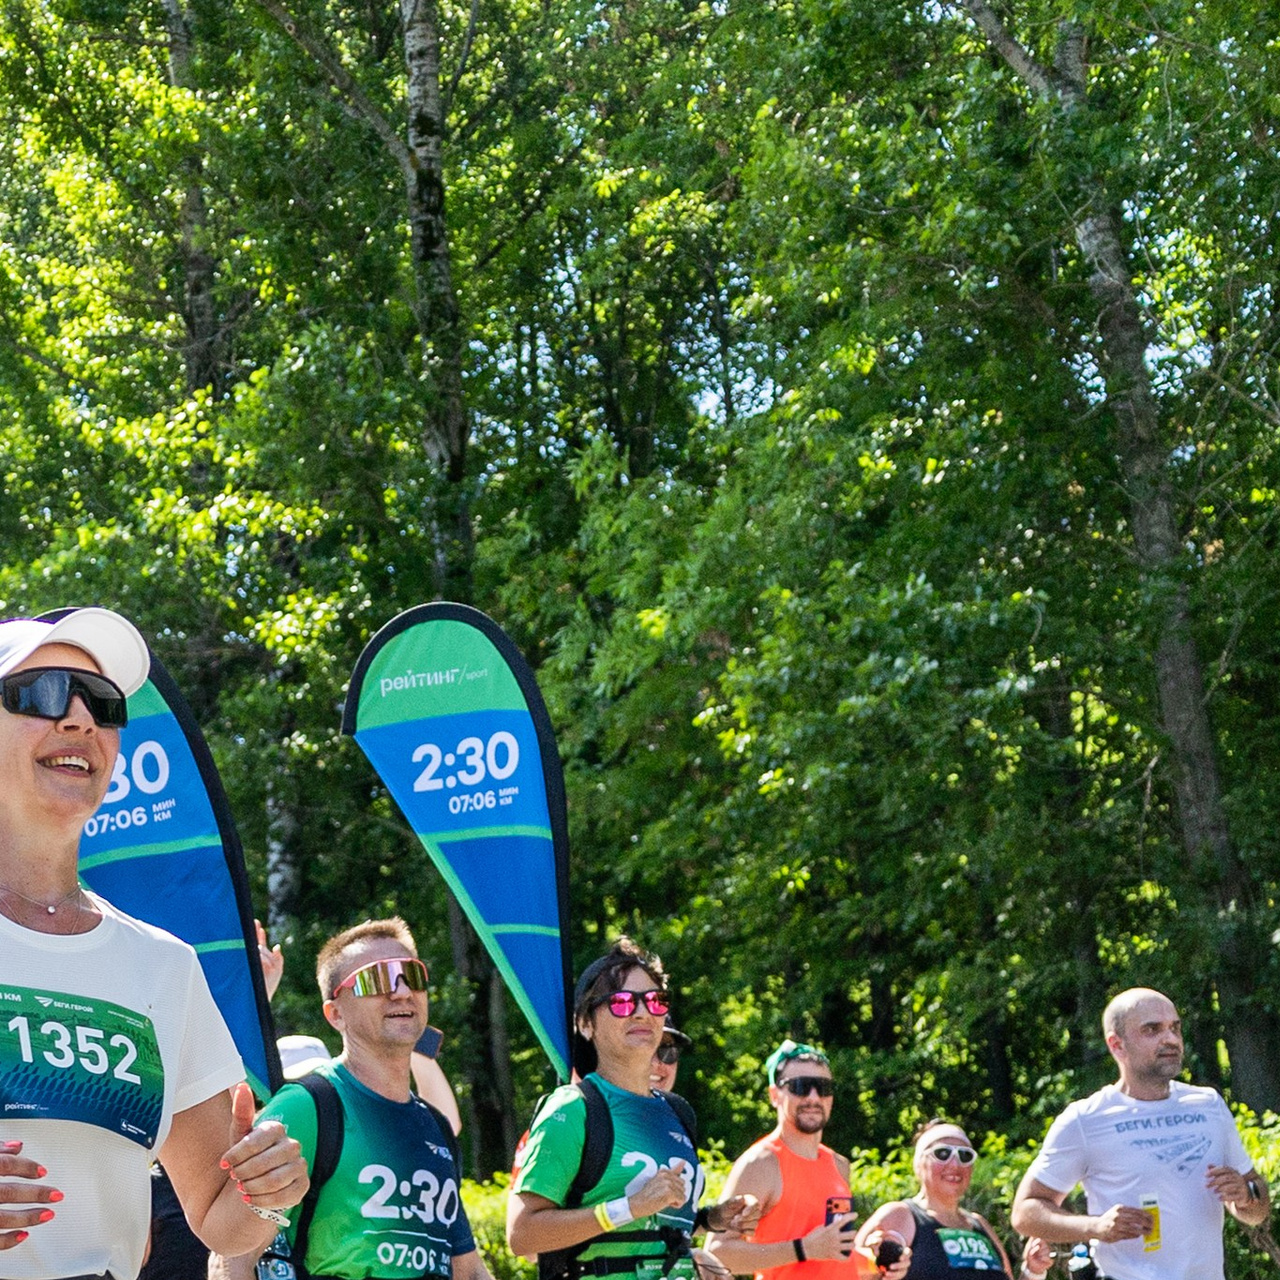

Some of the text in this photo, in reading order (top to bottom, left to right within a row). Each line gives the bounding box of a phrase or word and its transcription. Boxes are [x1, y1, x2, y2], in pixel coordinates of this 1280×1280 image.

[411, 731, 519, 792] 2:30
[152, 798, 176, 812] МИН
[153, 810, 171, 822] КМ
[448, 790, 496, 814] 07:06
[84, 806, 147, 837] 07:06
[8, 1015, 141, 1085] 1352
[358, 1164, 459, 1226] 2:30
